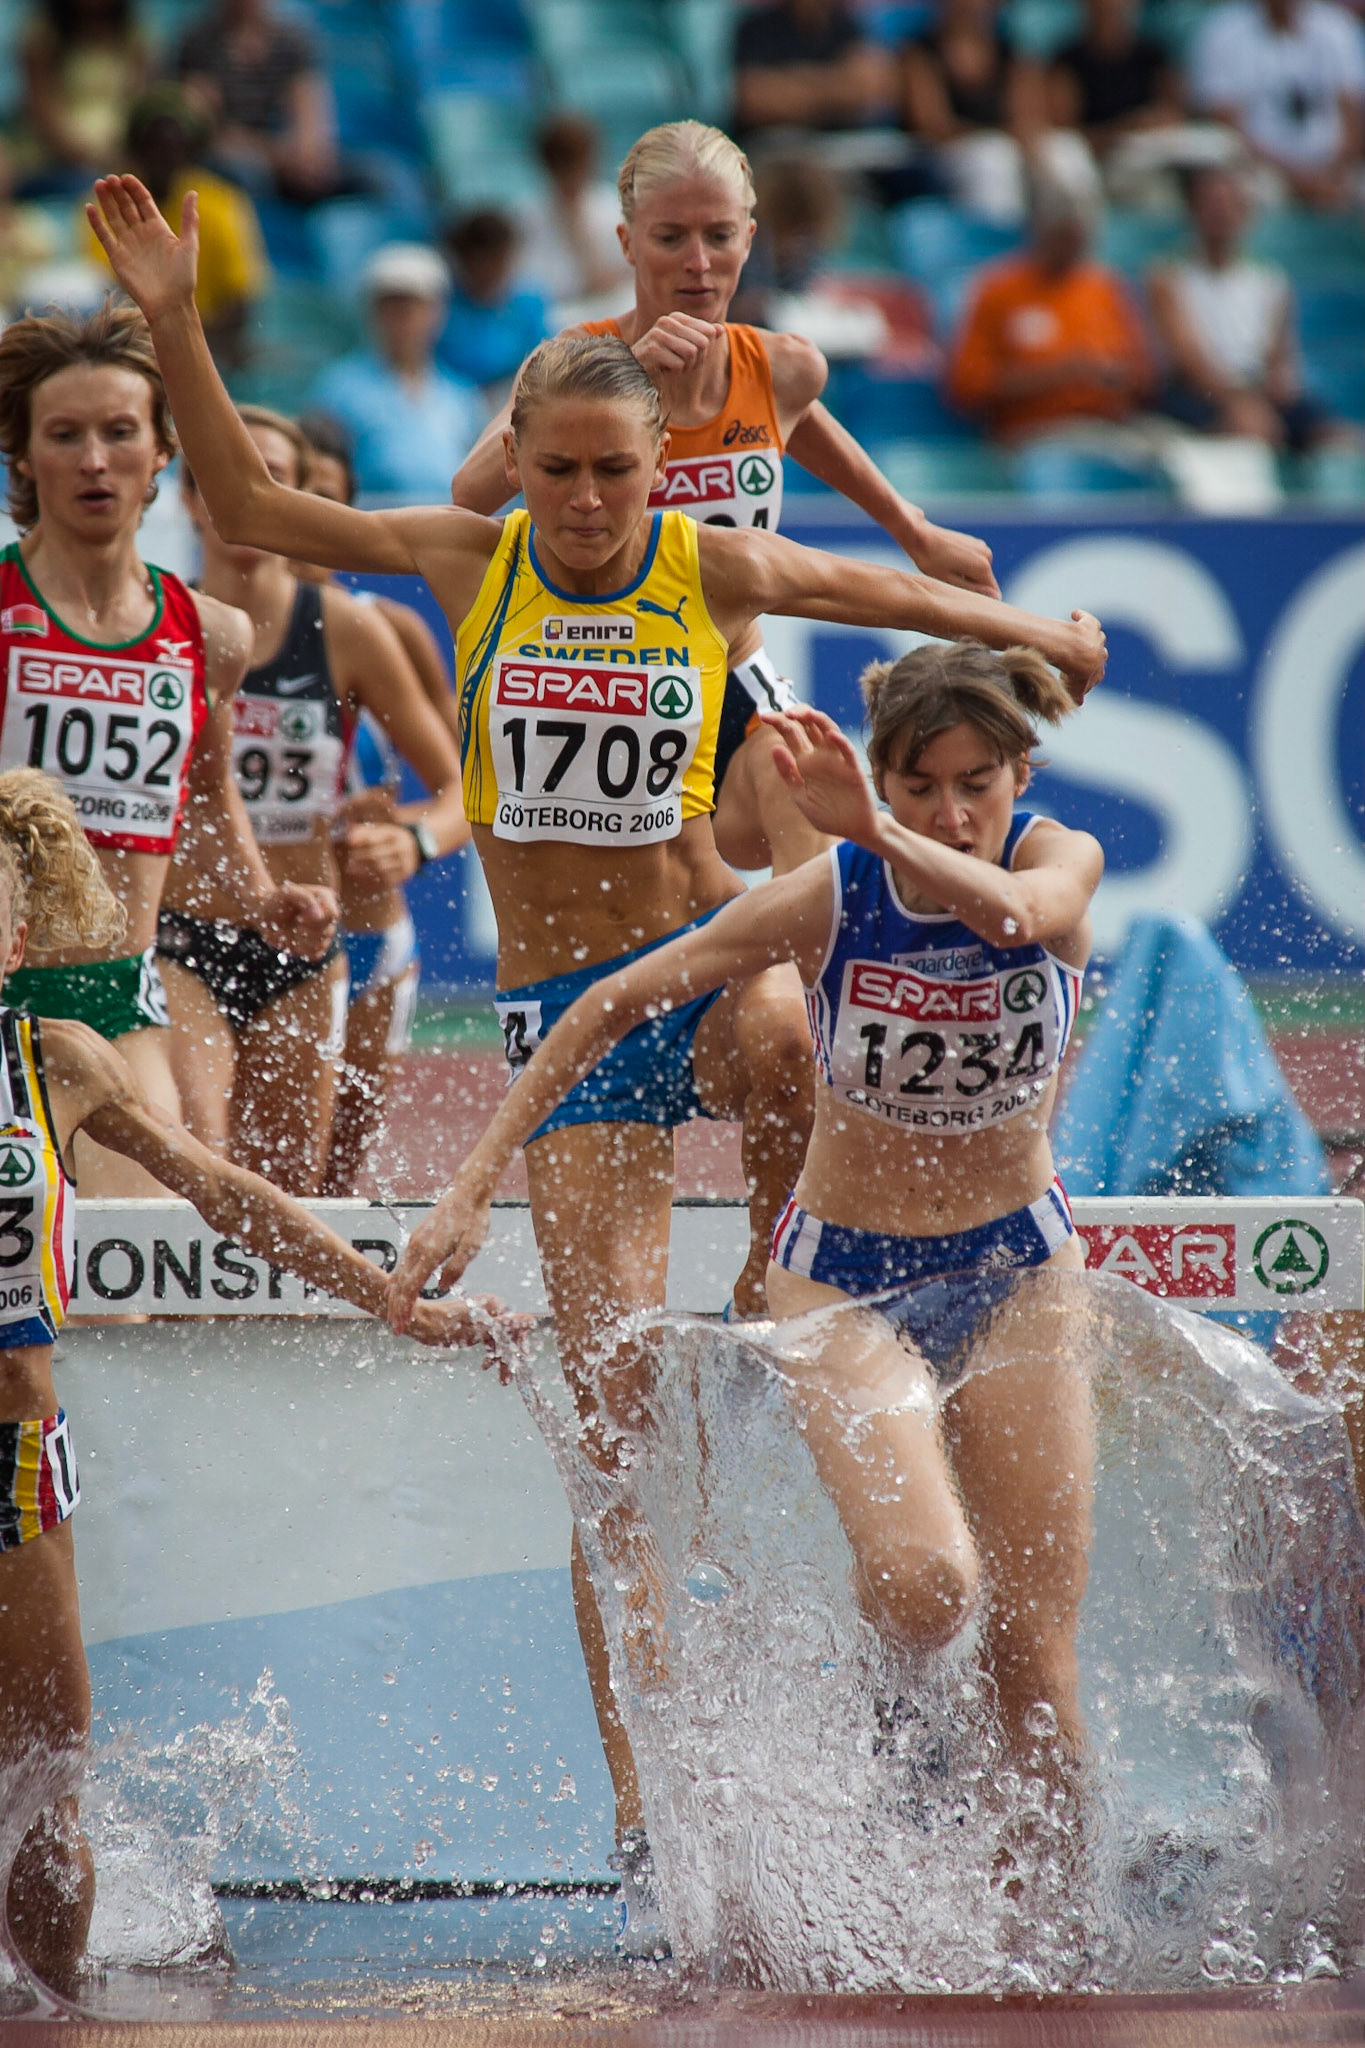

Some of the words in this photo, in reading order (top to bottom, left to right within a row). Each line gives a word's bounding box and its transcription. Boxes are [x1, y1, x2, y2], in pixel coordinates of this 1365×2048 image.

[650, 465, 732, 500] AR
[567, 624, 633, 640] eniro
[22, 662, 143, 701] SPAR
[503, 669, 643, 710] SPAR
[24, 703, 181, 786] 1052
[503, 718, 688, 799] 1708
[499, 803, 622, 833] GÖTEBORG
[629, 807, 674, 834] 2006
[856, 970, 998, 1017] SPAR
[860, 1021, 1047, 1098] 1234
[1082, 1233, 1229, 1281] AR
